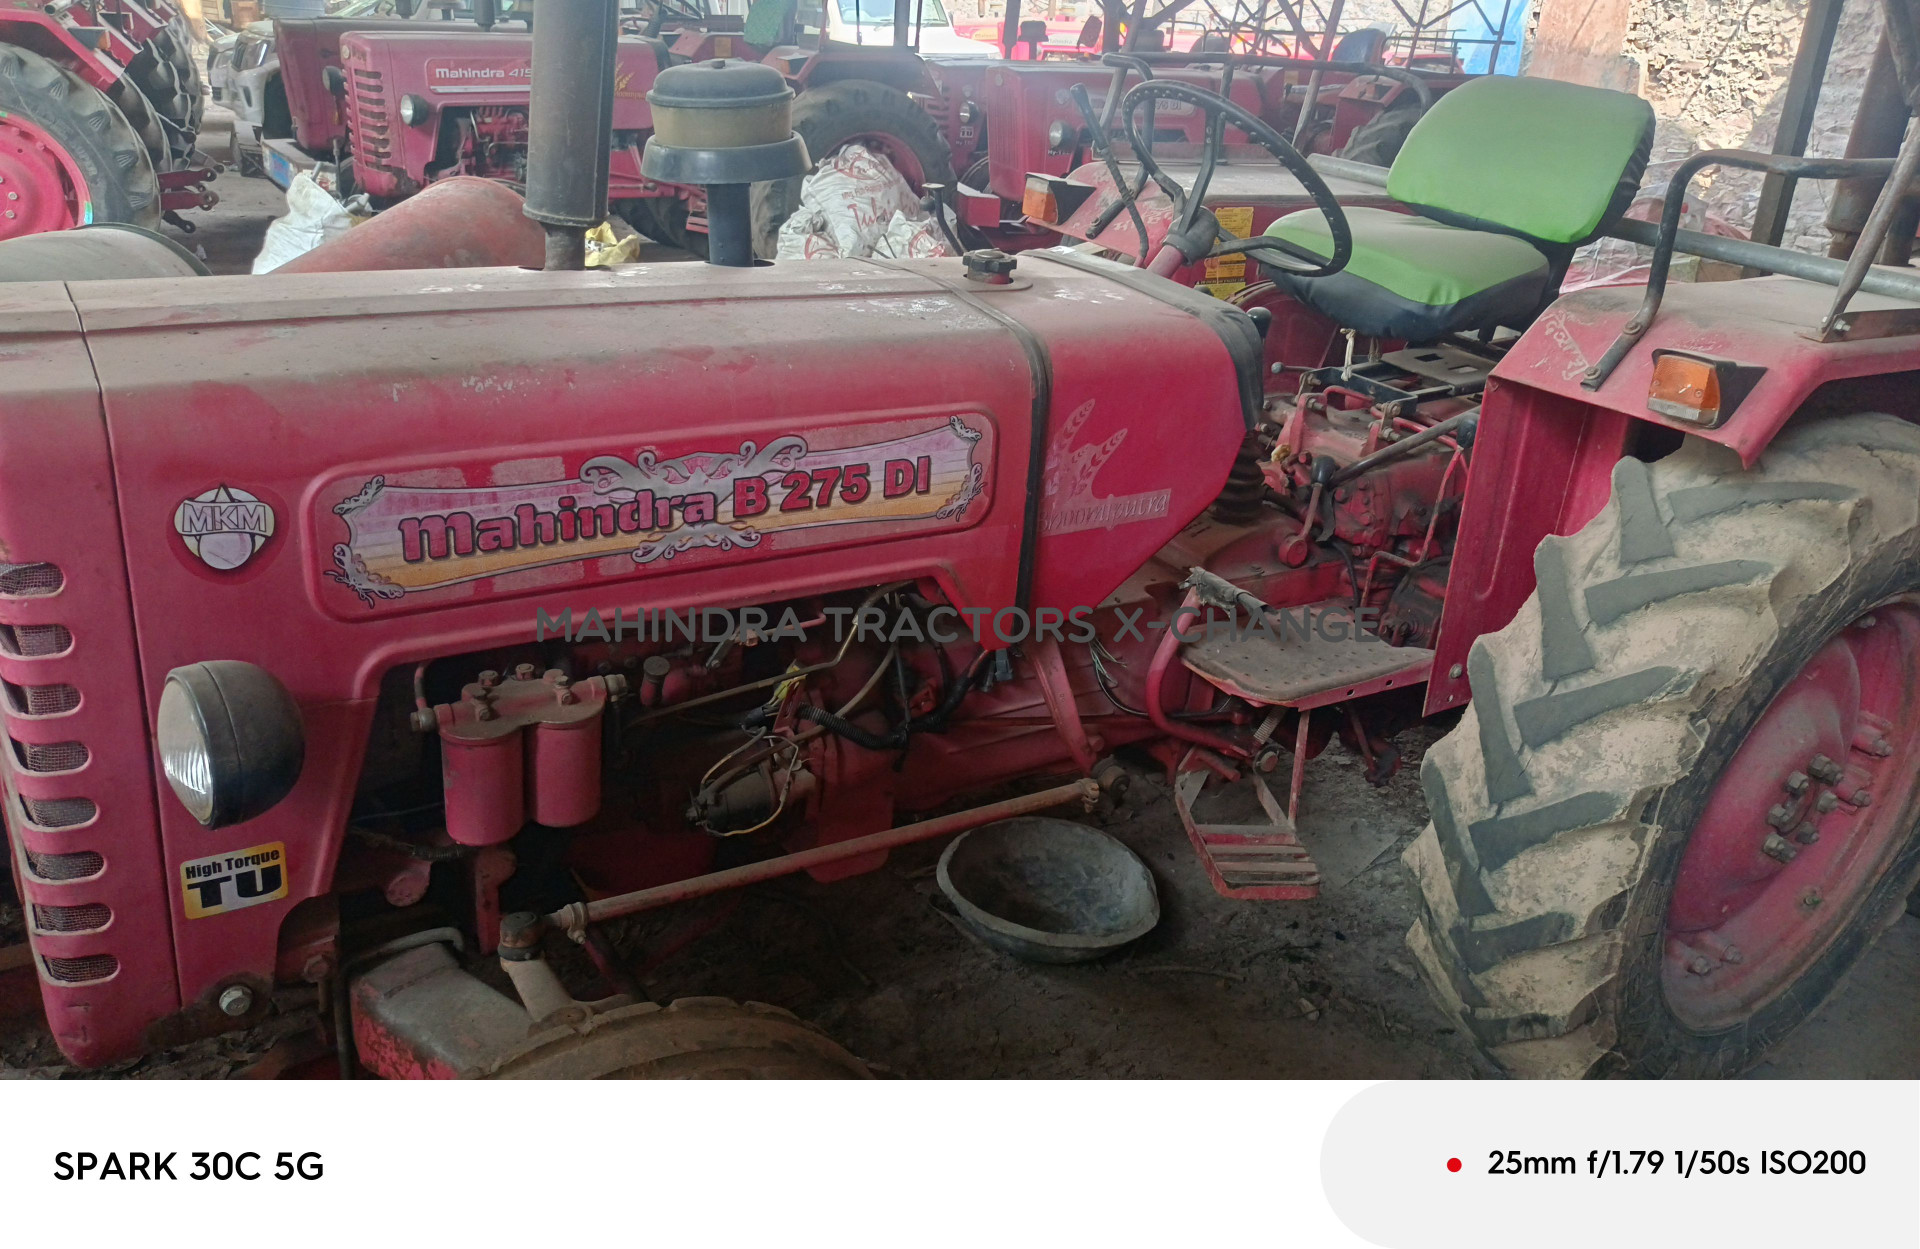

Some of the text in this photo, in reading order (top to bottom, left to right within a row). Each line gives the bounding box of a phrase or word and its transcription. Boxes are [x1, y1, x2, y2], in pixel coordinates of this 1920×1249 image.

[435, 68, 505, 78] Mahindra
[182, 502, 267, 534] MKM
[398, 455, 932, 563] Mahindra B 275 DI
[185, 849, 280, 880] High Torque
[187, 864, 282, 908] TU
